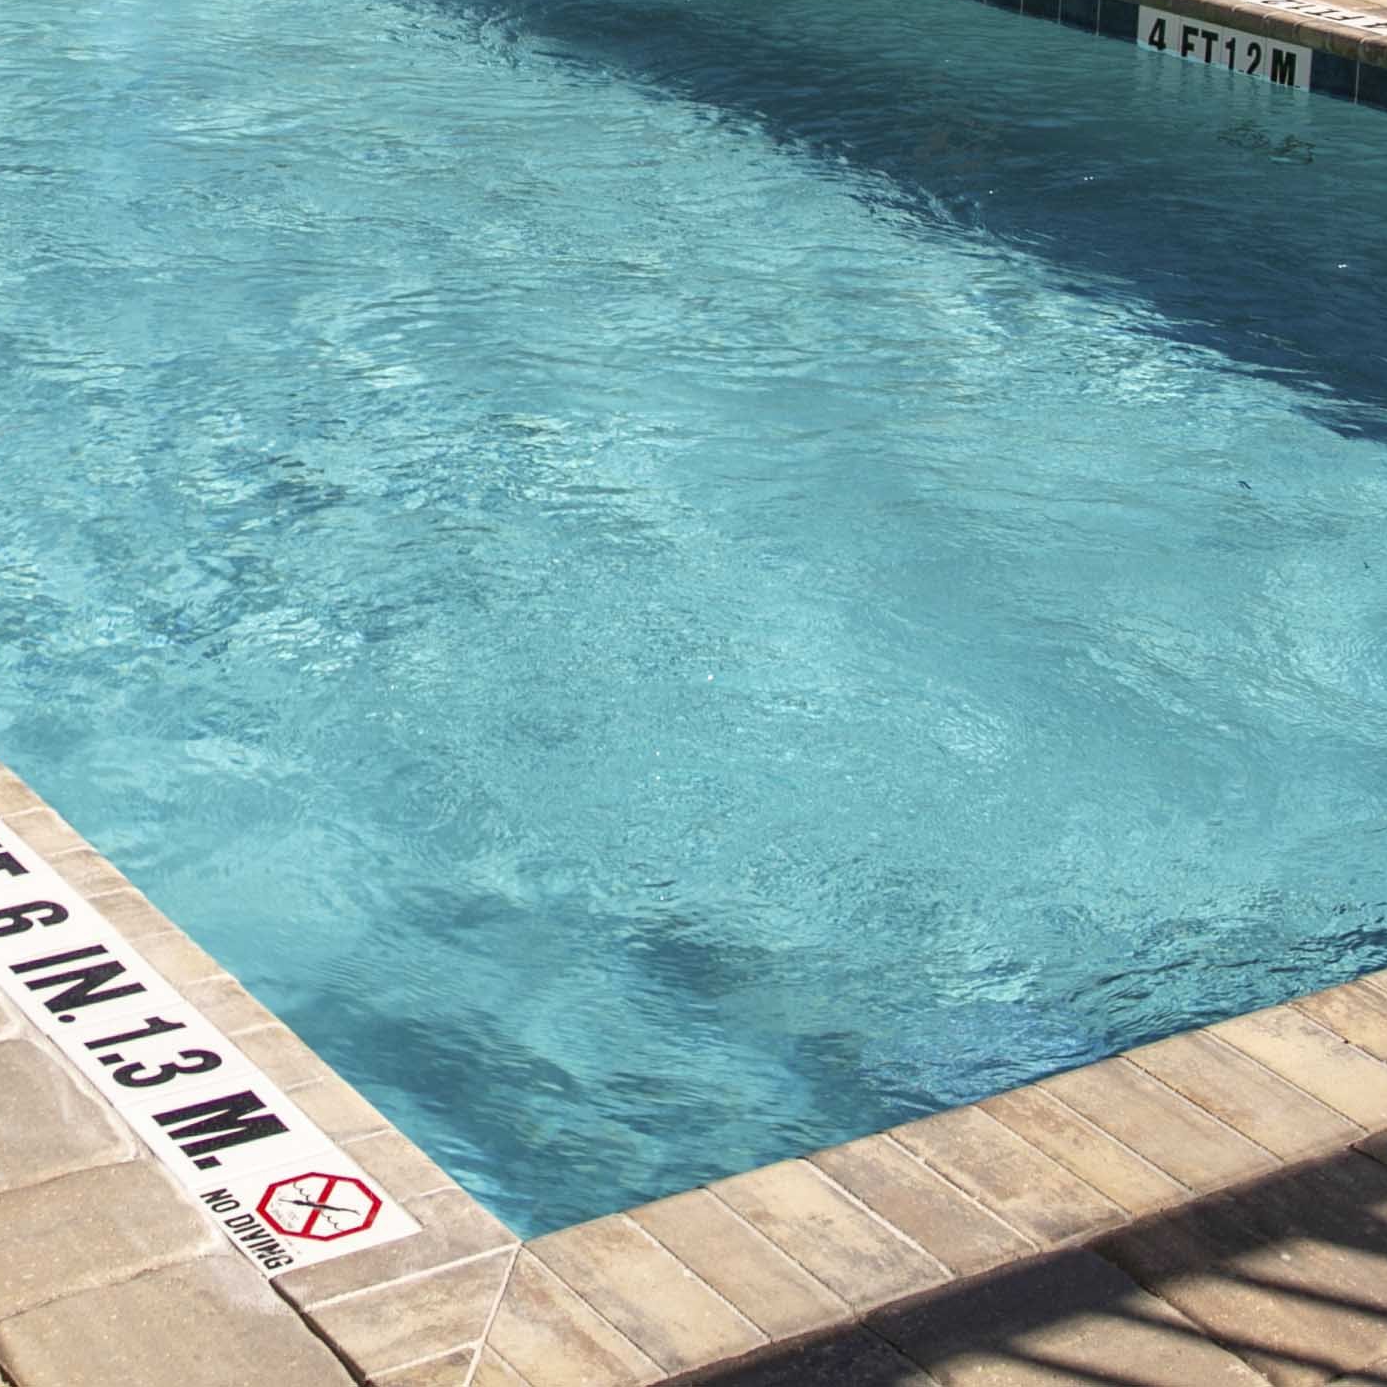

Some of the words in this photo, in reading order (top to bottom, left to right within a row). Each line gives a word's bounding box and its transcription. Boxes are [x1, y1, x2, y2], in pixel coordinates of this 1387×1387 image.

[1148, 17, 1167, 52] 4
[8, 944, 148, 1024] IN.
[83, 1015, 223, 1089] 1.3
[151, 1089, 290, 1171] M.
[199, 1187, 240, 1214] NO
[223, 1213, 295, 1271] DIVING
